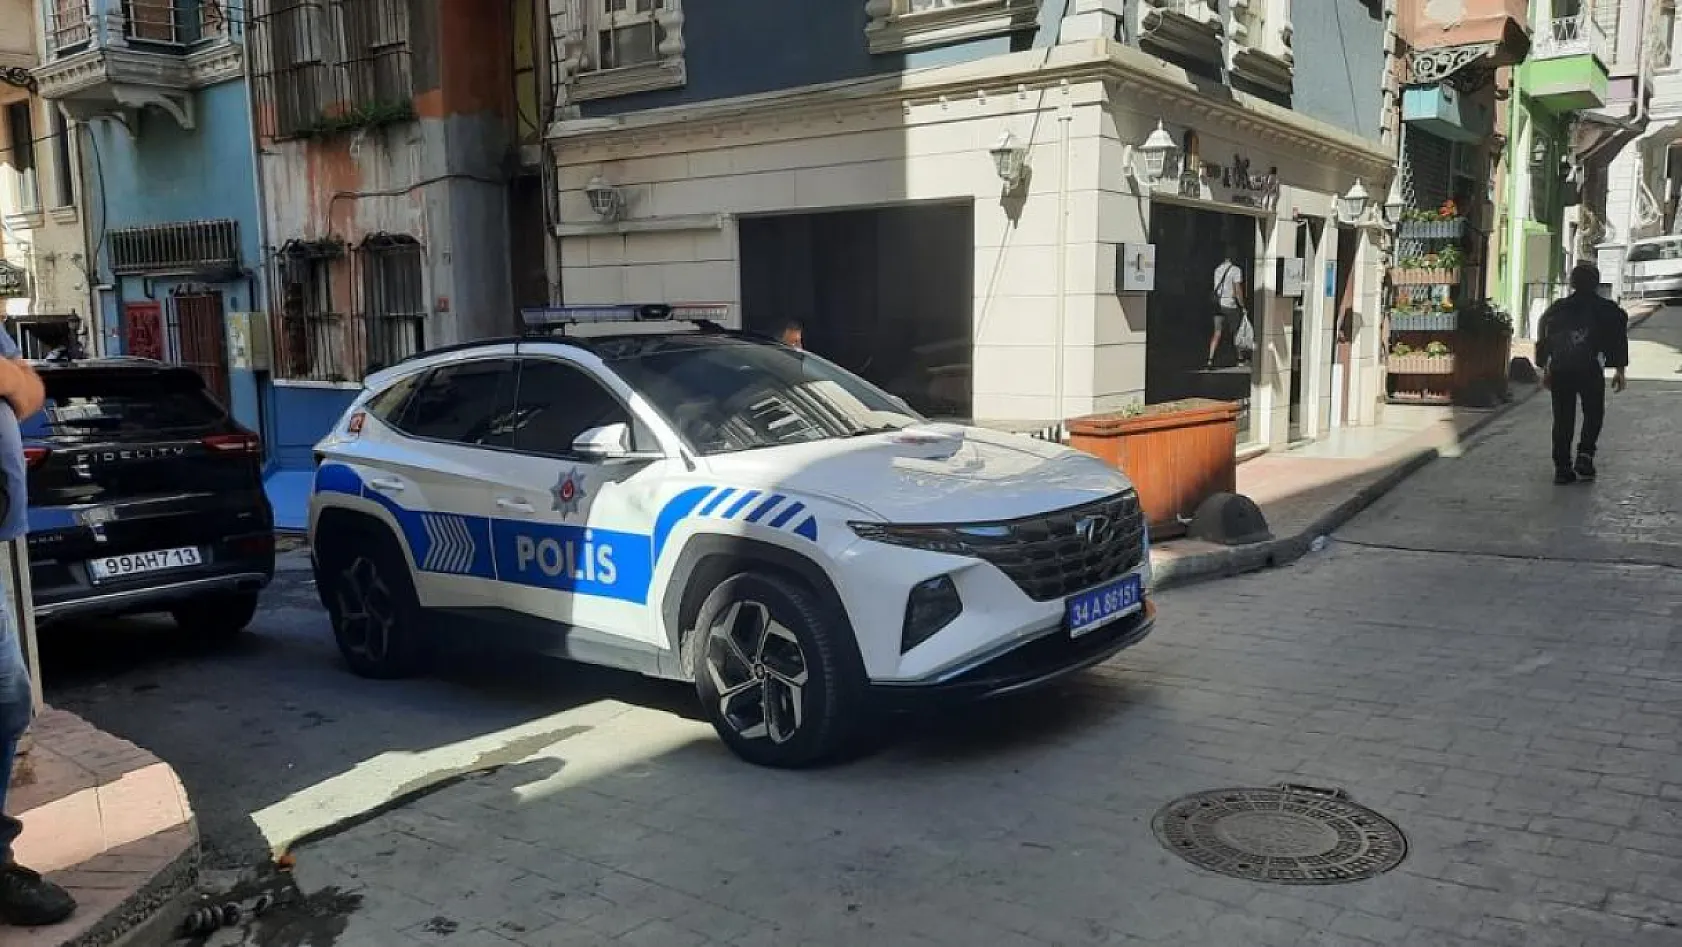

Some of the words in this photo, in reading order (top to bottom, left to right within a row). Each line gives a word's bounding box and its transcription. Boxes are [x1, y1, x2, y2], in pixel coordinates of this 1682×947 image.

[77, 447, 184, 463] FIDELITY
[516, 528, 617, 585] POLİS
[1071, 601, 1089, 626] 34
[1092, 596, 1102, 621] A
